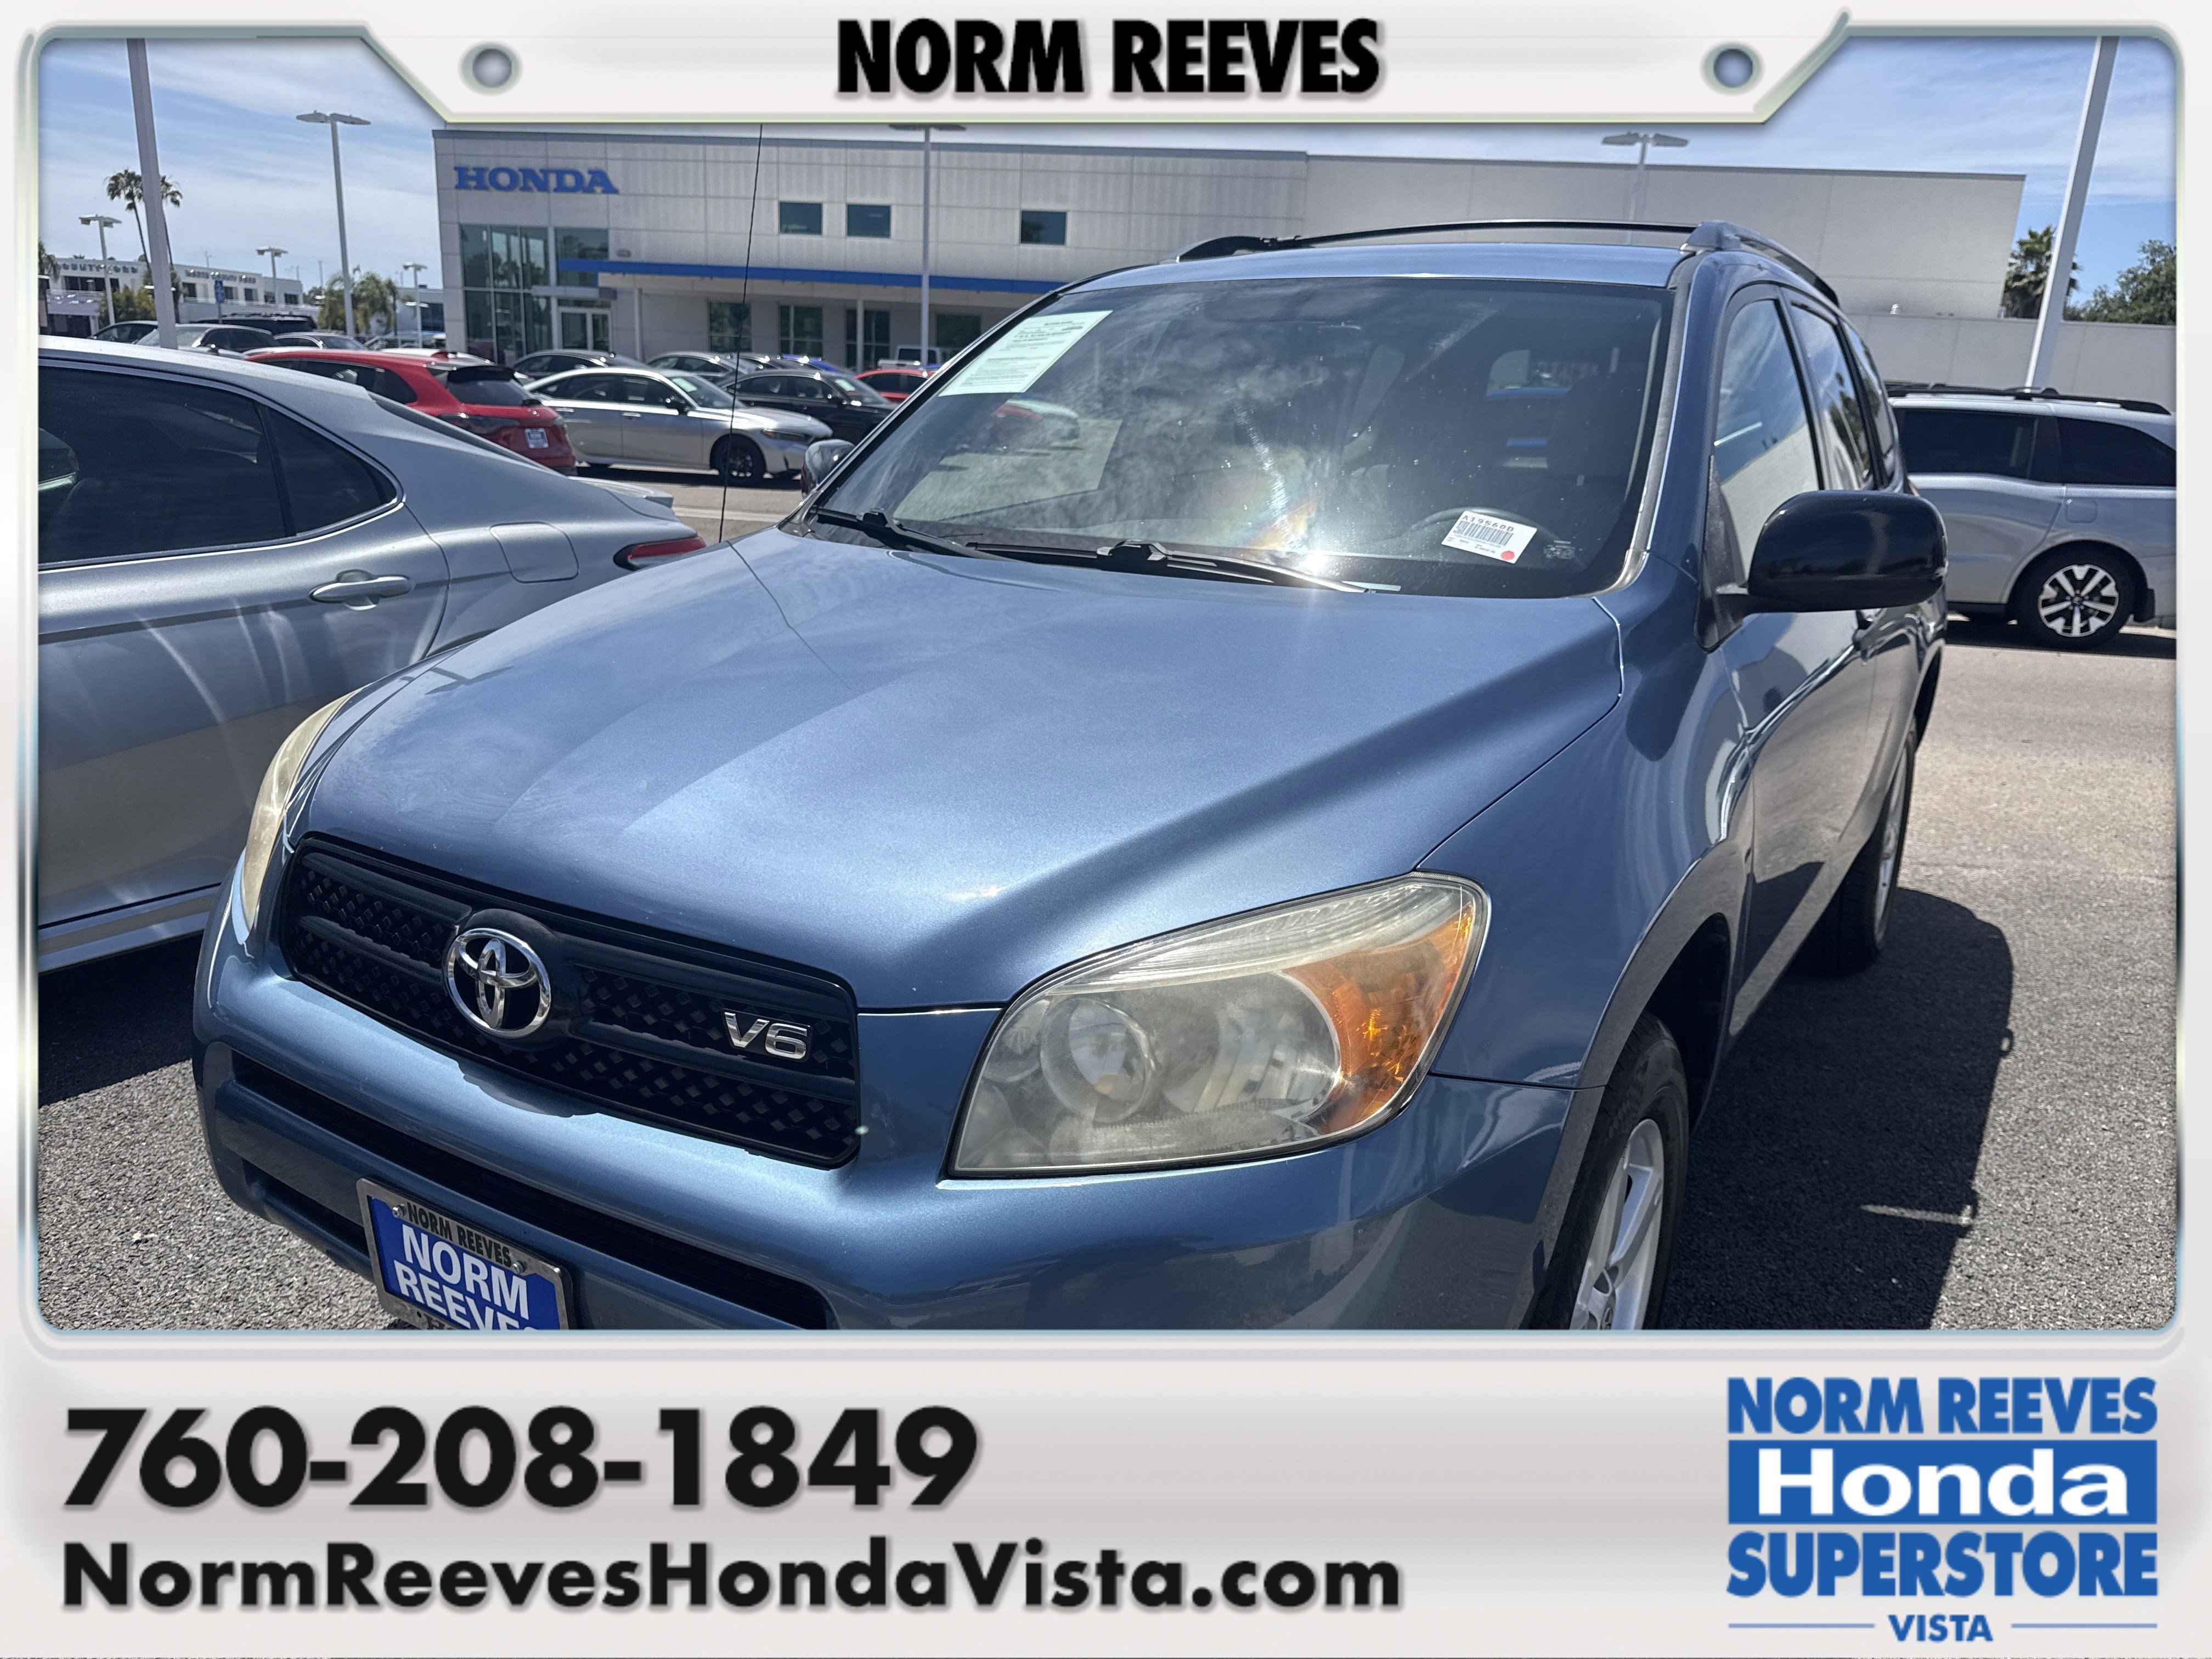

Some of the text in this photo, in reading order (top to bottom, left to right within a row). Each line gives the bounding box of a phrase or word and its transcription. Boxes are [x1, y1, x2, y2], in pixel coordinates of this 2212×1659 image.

[454, 166, 619, 194] HONDA
[724, 1012, 808, 1059] V6
[407, 1202, 512, 1268] NORM REEVES
[393, 1260, 538, 1330] REEVE
[402, 1223, 529, 1321] NORM
